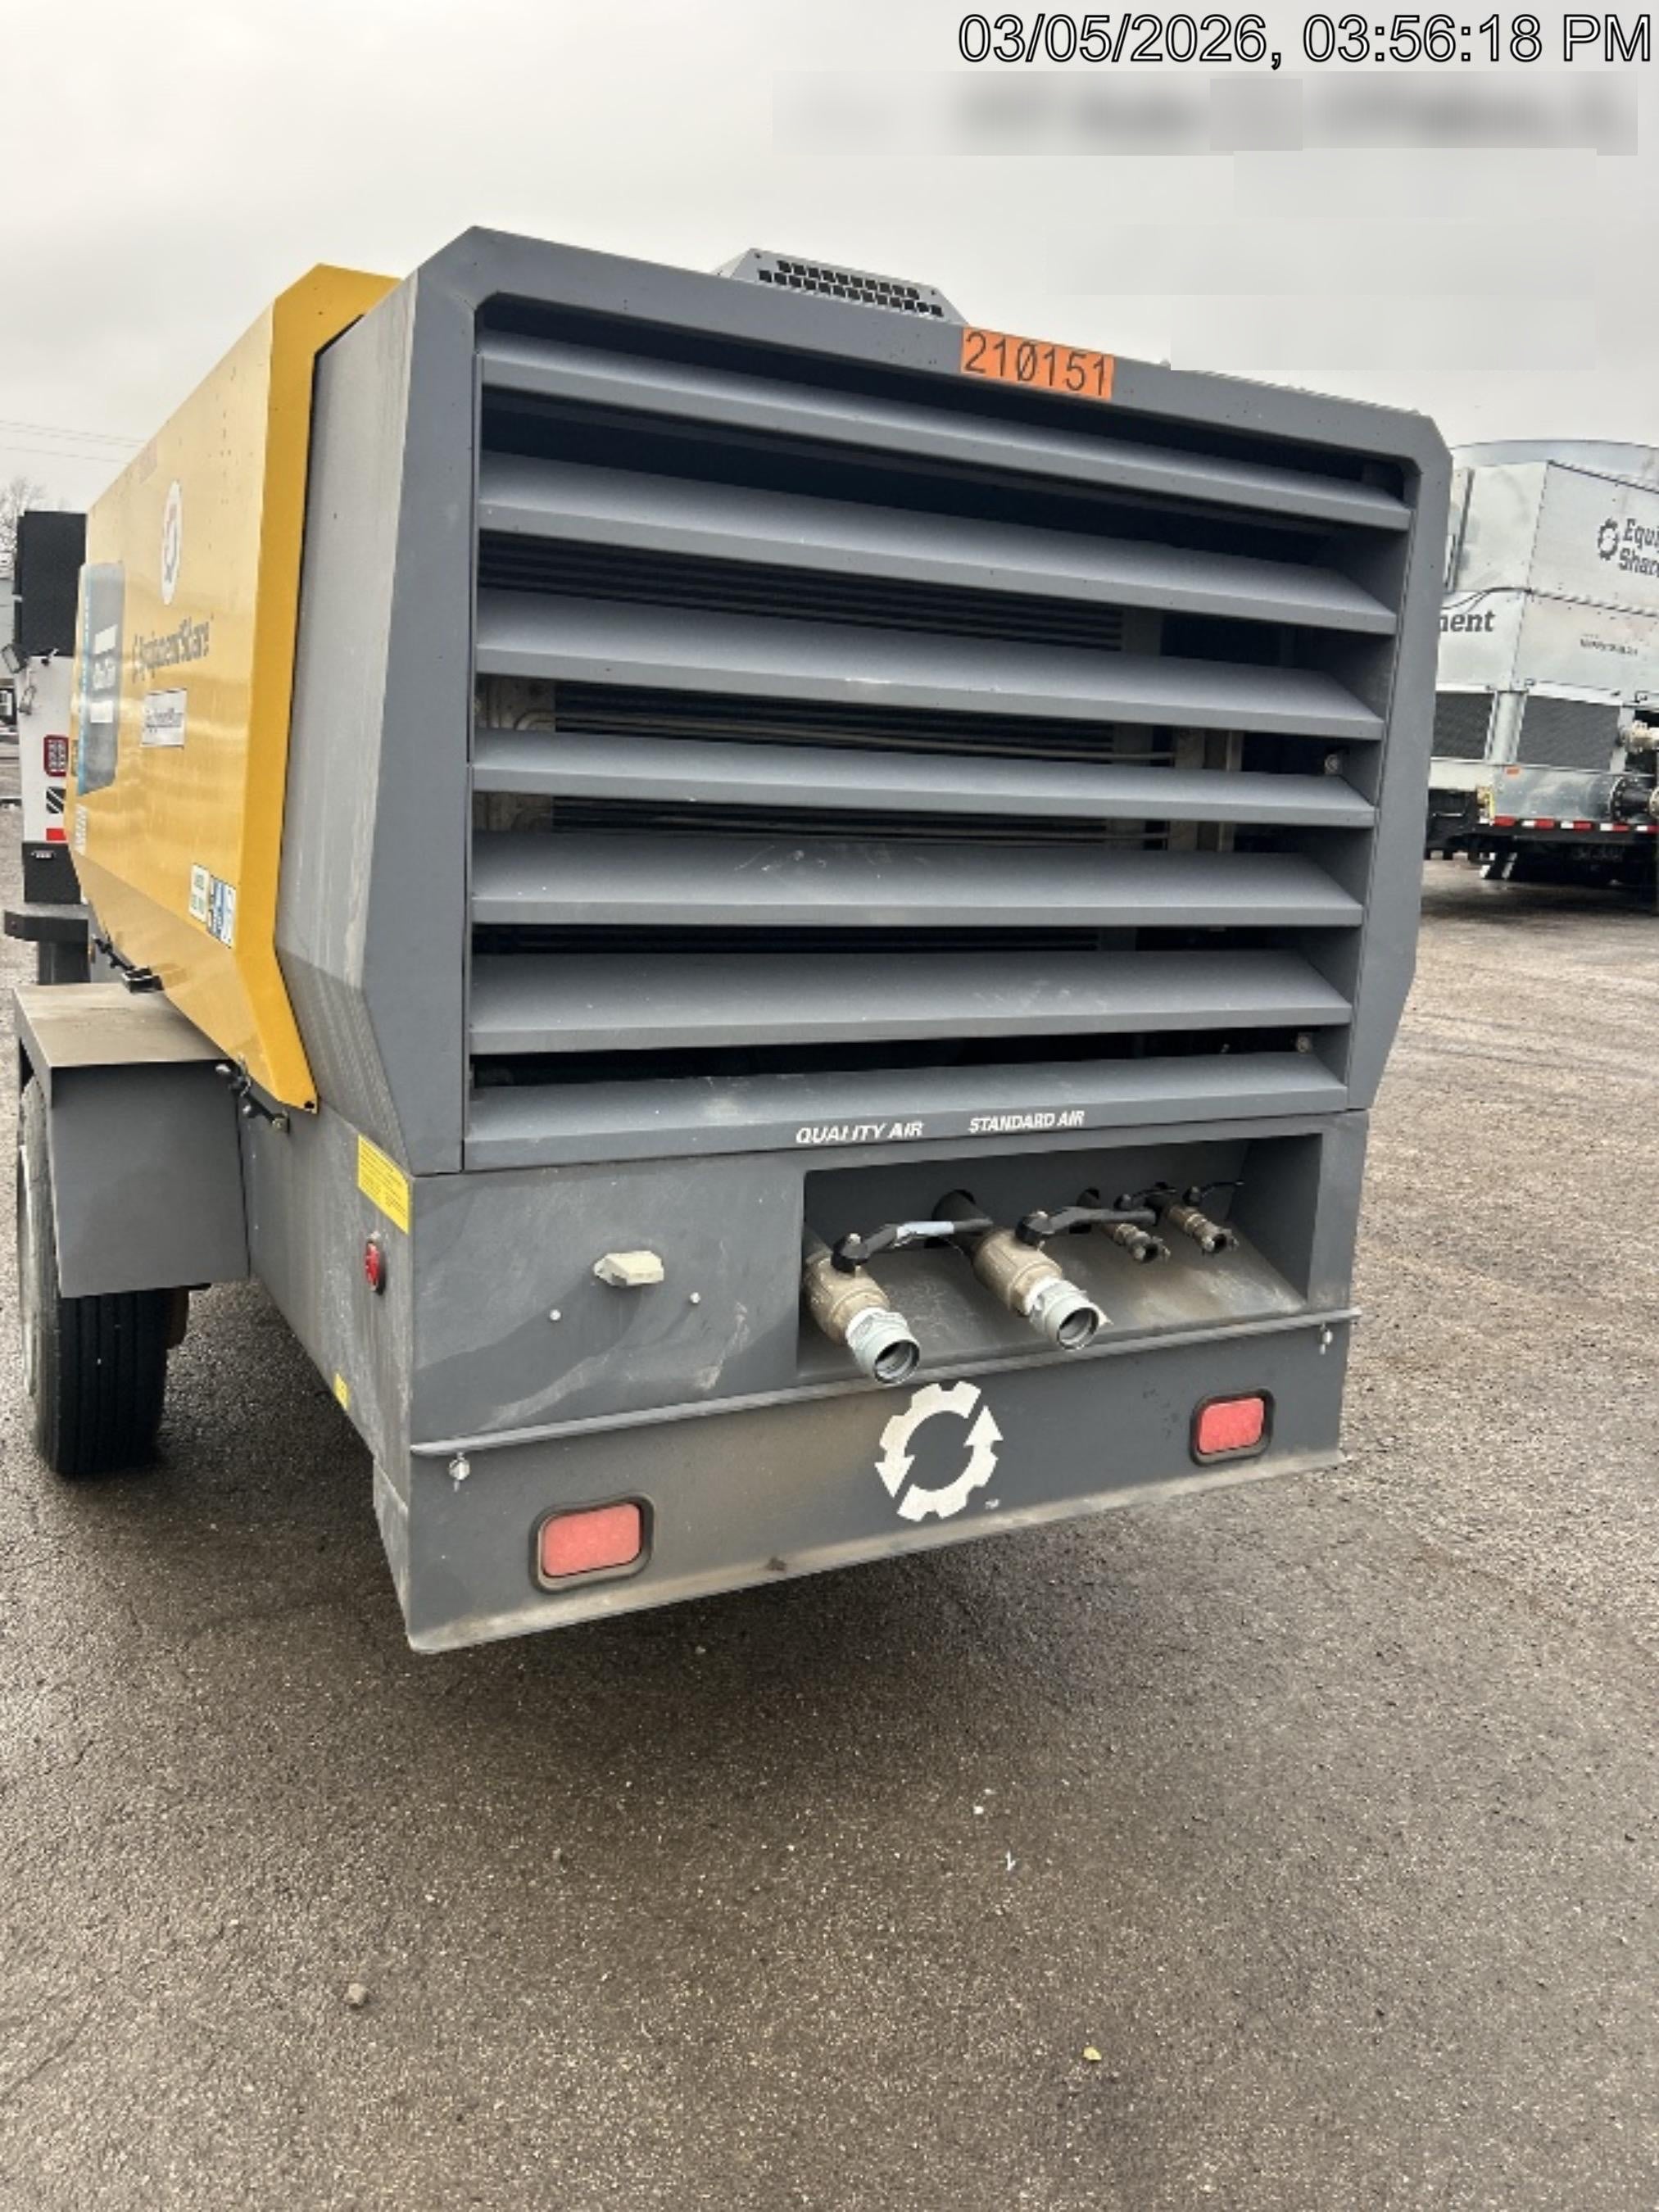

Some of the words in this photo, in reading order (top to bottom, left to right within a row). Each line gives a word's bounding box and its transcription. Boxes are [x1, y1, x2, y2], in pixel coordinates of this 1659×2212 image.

[964, 331, 1104, 396] 210151
[796, 1122, 887, 1144] QUALITY
[887, 1120, 923, 1139] AIR
[968, 1113, 1055, 1133] STANDARD
[1057, 1110, 1085, 1127] AIR
